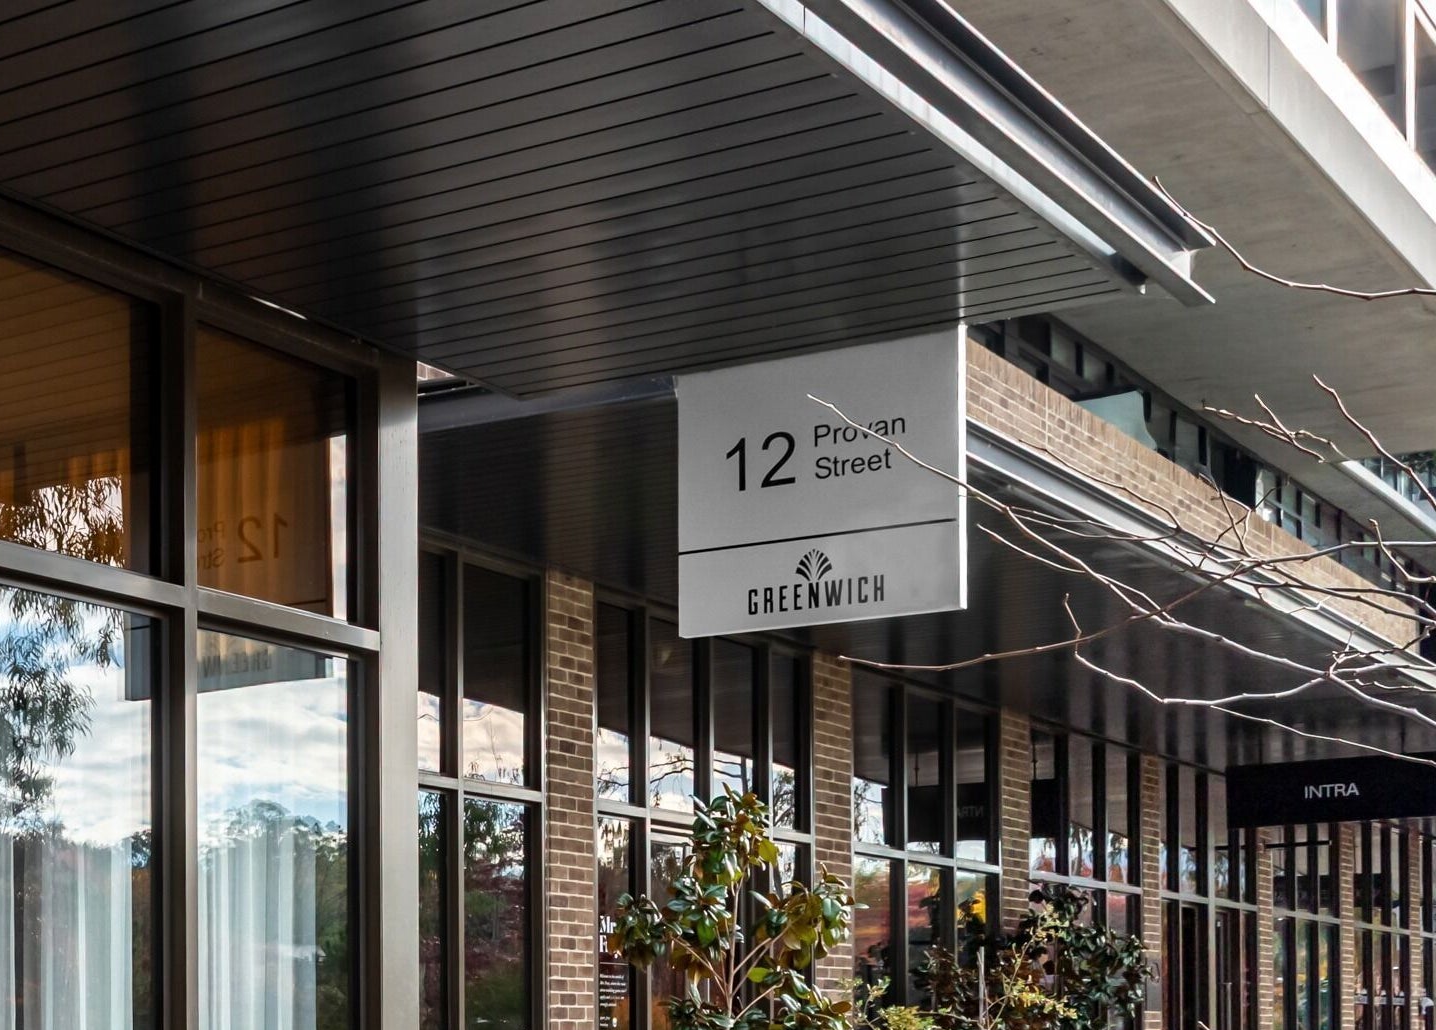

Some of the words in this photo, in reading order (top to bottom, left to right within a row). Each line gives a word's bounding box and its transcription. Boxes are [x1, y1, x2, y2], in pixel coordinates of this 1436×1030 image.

[814, 417, 906, 447] Provan
[726, 431, 796, 491] 12
[815, 448, 892, 479] Street
[748, 574, 885, 615] GREENWICH
[1304, 782, 1360, 799] INTRA
